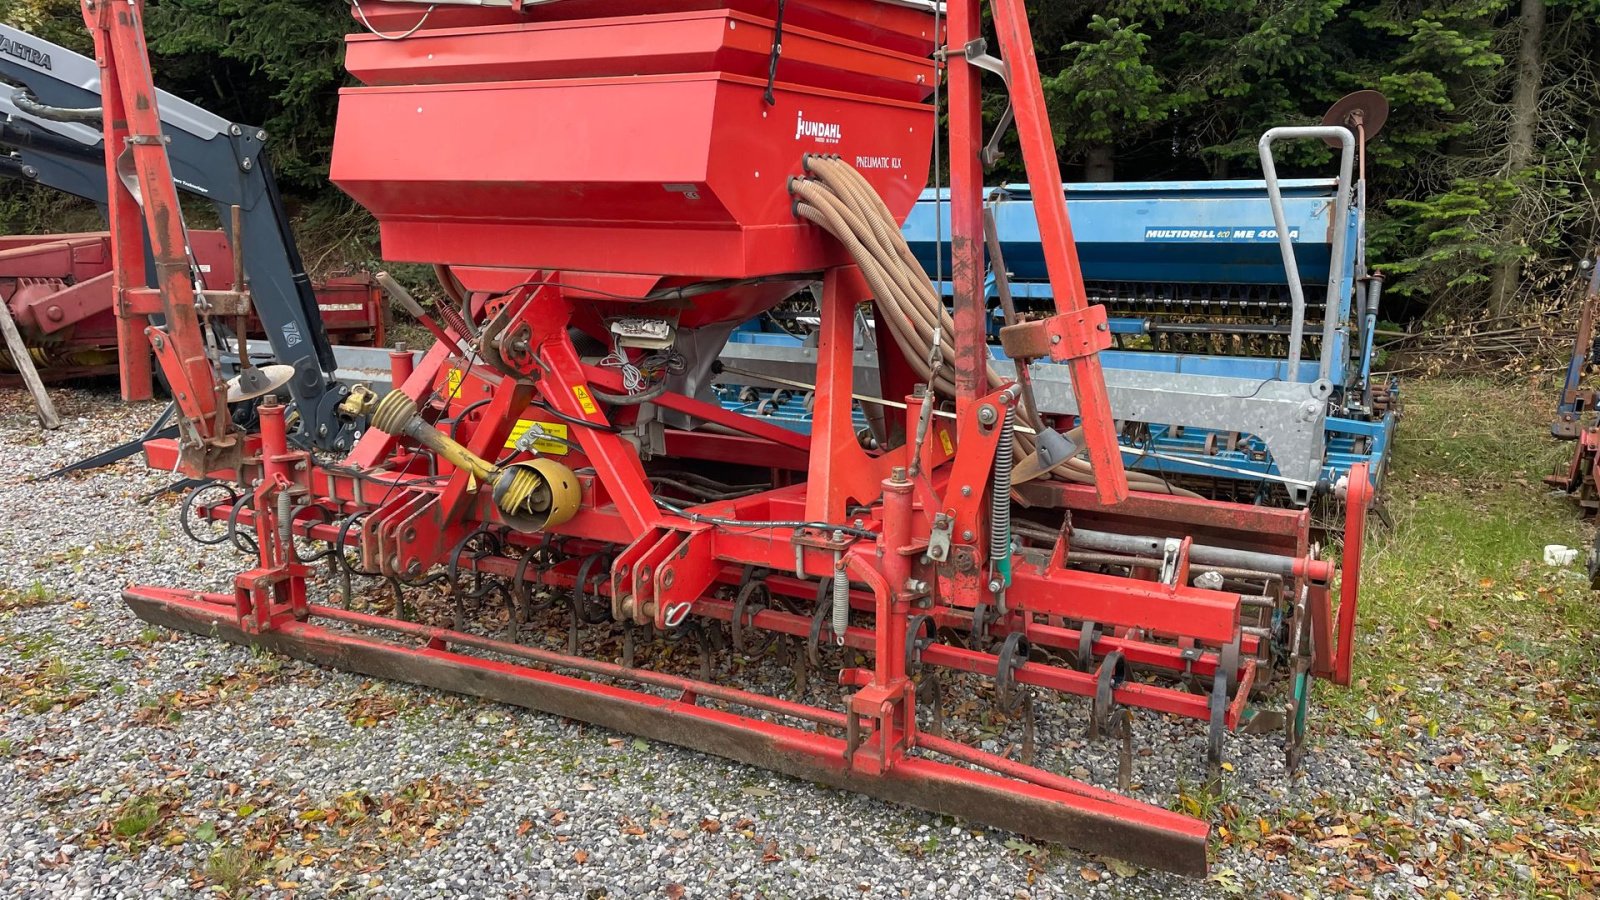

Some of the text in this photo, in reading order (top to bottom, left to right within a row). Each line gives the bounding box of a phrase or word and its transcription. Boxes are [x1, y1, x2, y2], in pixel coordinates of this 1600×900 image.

[856, 156, 890, 169] PNEUMATIC
[1145, 230, 1216, 238] MULTIDRILL
[1233, 230, 1256, 238] ME
